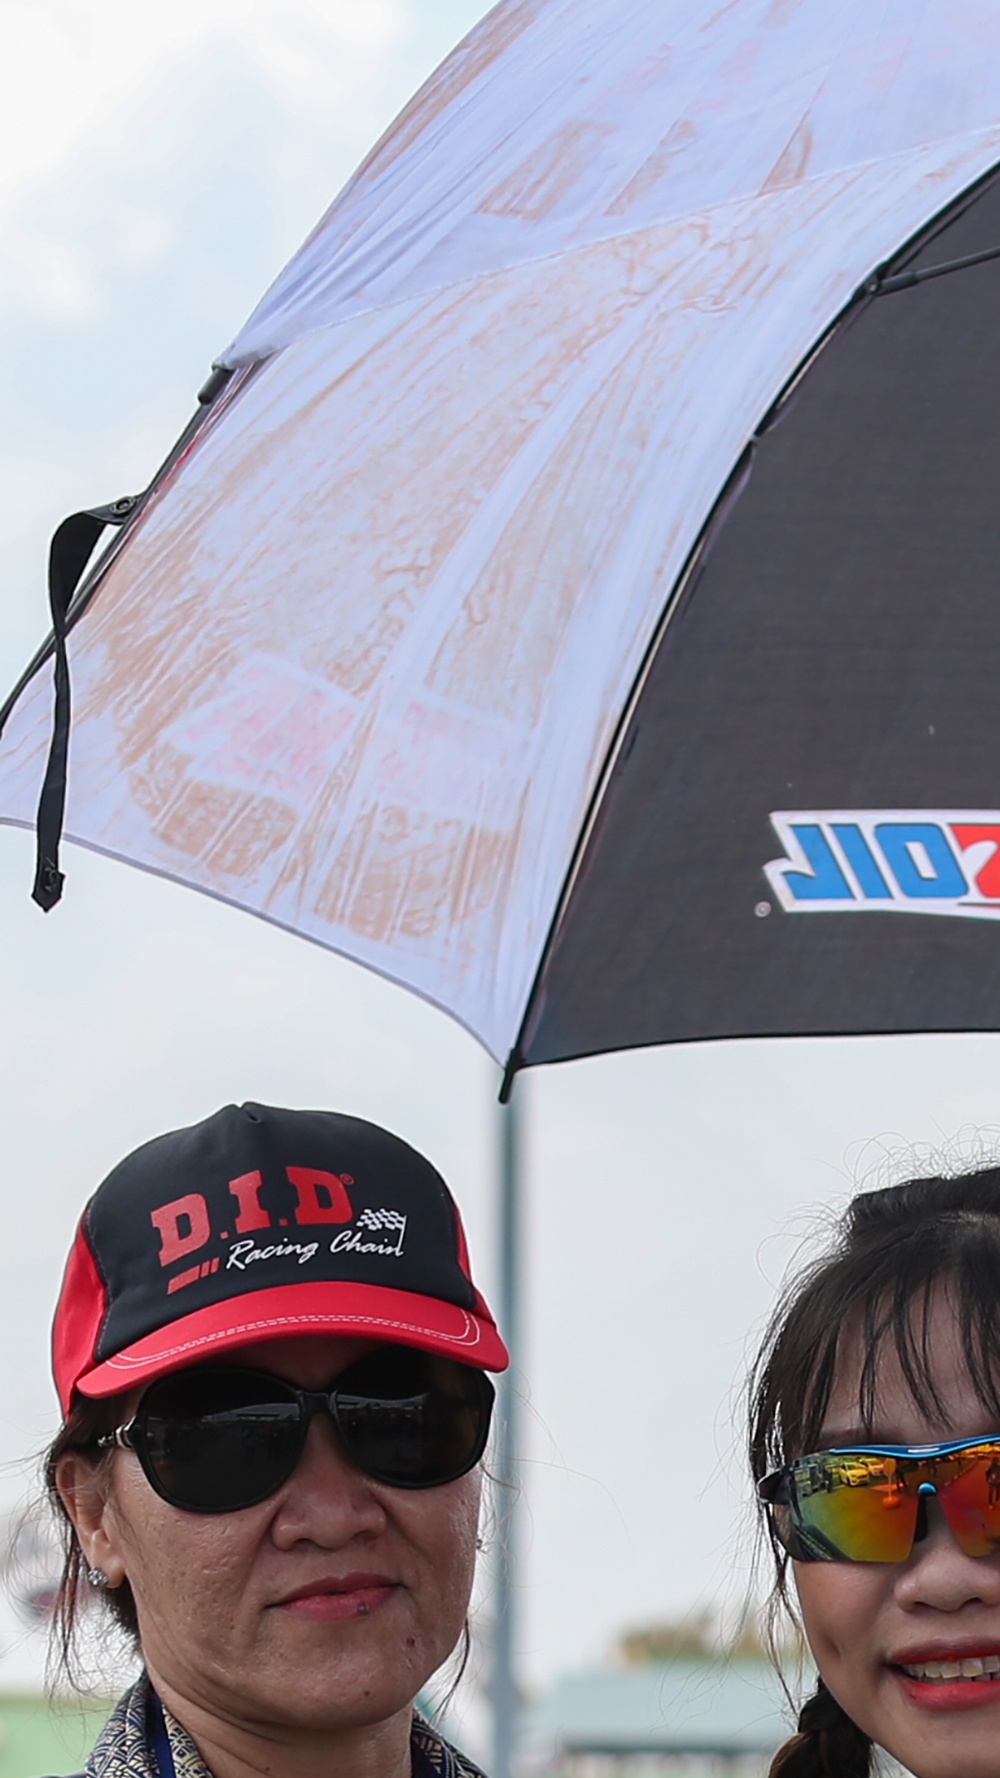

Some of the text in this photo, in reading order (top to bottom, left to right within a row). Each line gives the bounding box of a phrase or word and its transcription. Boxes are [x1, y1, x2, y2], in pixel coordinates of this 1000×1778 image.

[150, 1165, 353, 1268] D.I.D
[225, 1230, 404, 1271] Racing Chain
